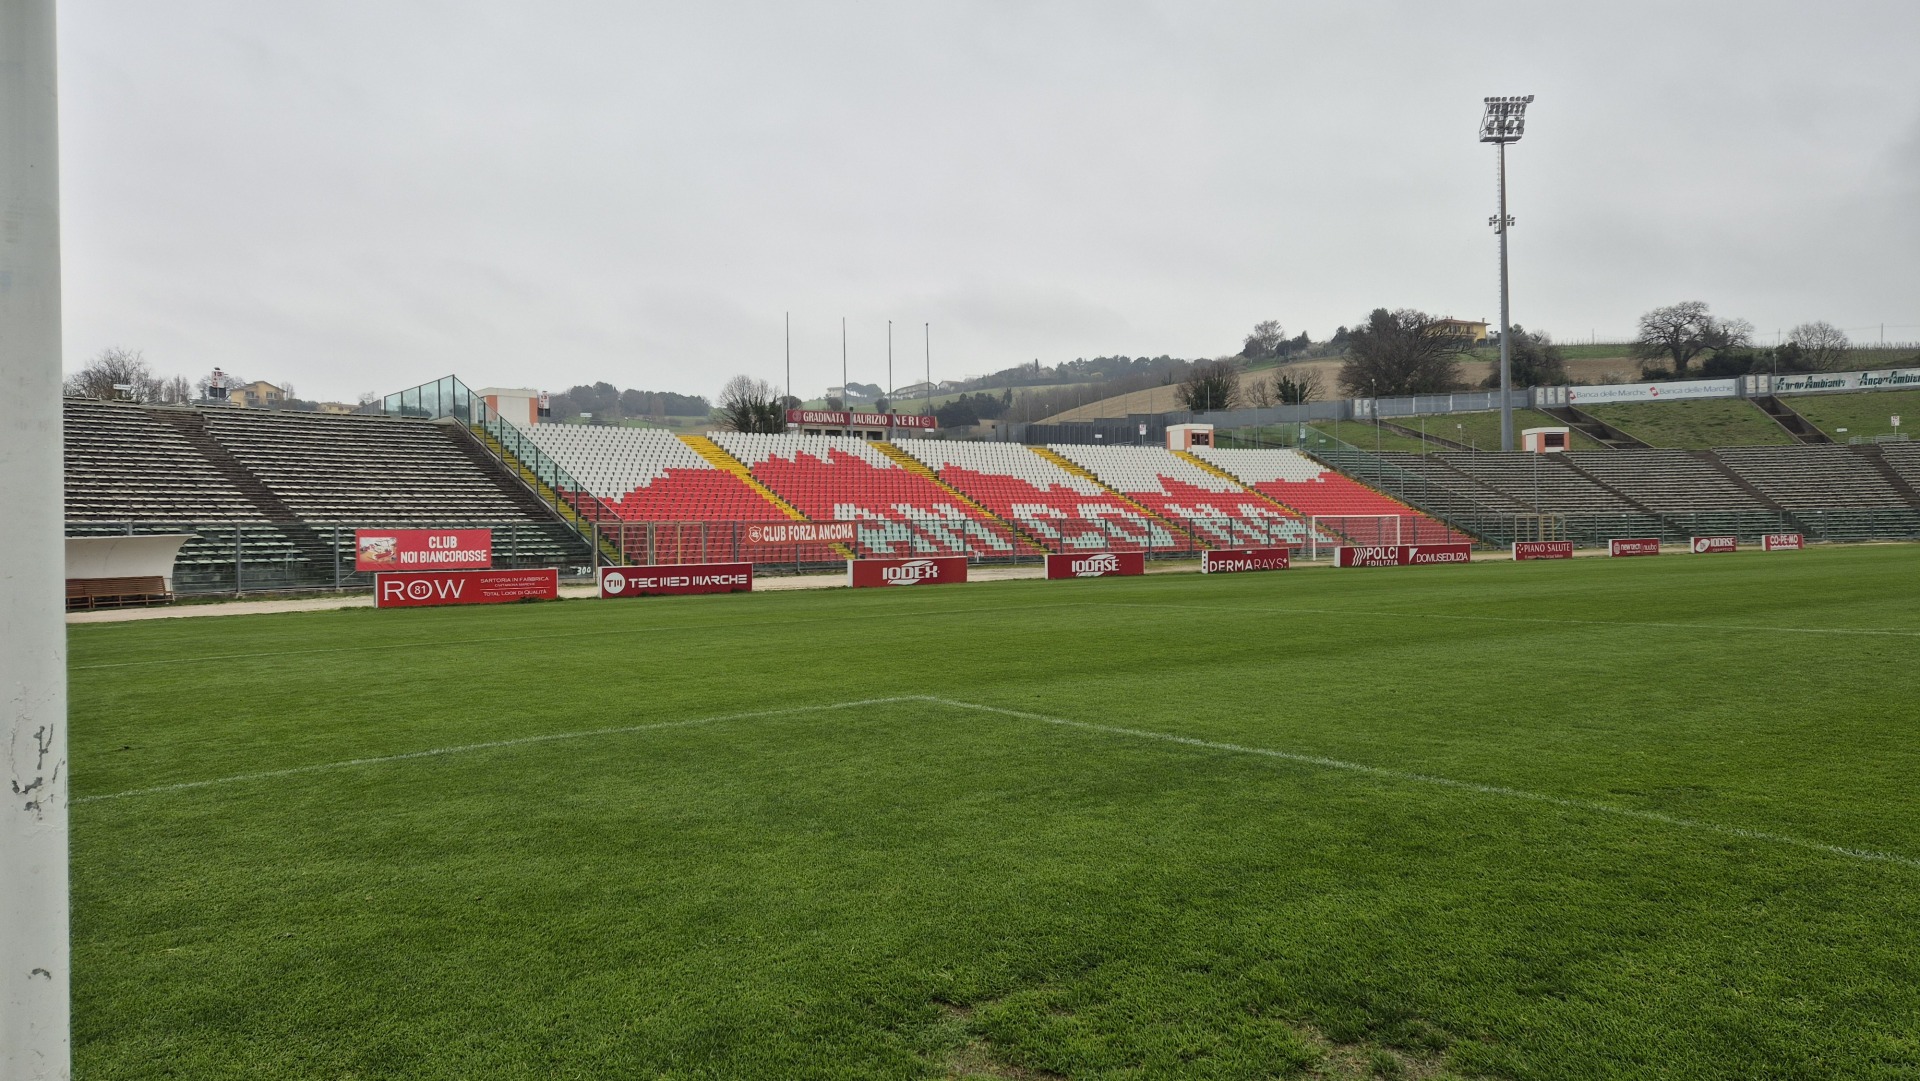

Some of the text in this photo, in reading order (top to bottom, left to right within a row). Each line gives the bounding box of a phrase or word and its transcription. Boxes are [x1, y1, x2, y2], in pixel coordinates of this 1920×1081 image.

[1659, 387, 1683, 395] Banca
[803, 412, 845, 423] GRADINATA
[763, 524, 854, 542] CLUB FORZA ANCONA
[428, 536, 458, 549] CLUB
[1524, 543, 1571, 552] PIANO SALUTE
[1710, 538, 1735, 547] IODASE
[400, 549, 487, 564] NOI BIANCOROSSE
[1366, 546, 1399, 560] POLCI
[1416, 552, 1468, 563] DOMUSEDILIZIA
[1071, 559, 1120, 573] IODASE
[1209, 557, 1284, 572] DERMARAYS
[882, 565, 938, 580] IODEX
[628, 574, 748, 588] TEC MED MARCHE
[383, 578, 466, 601] ROW
[414, 585, 426, 595] 81
